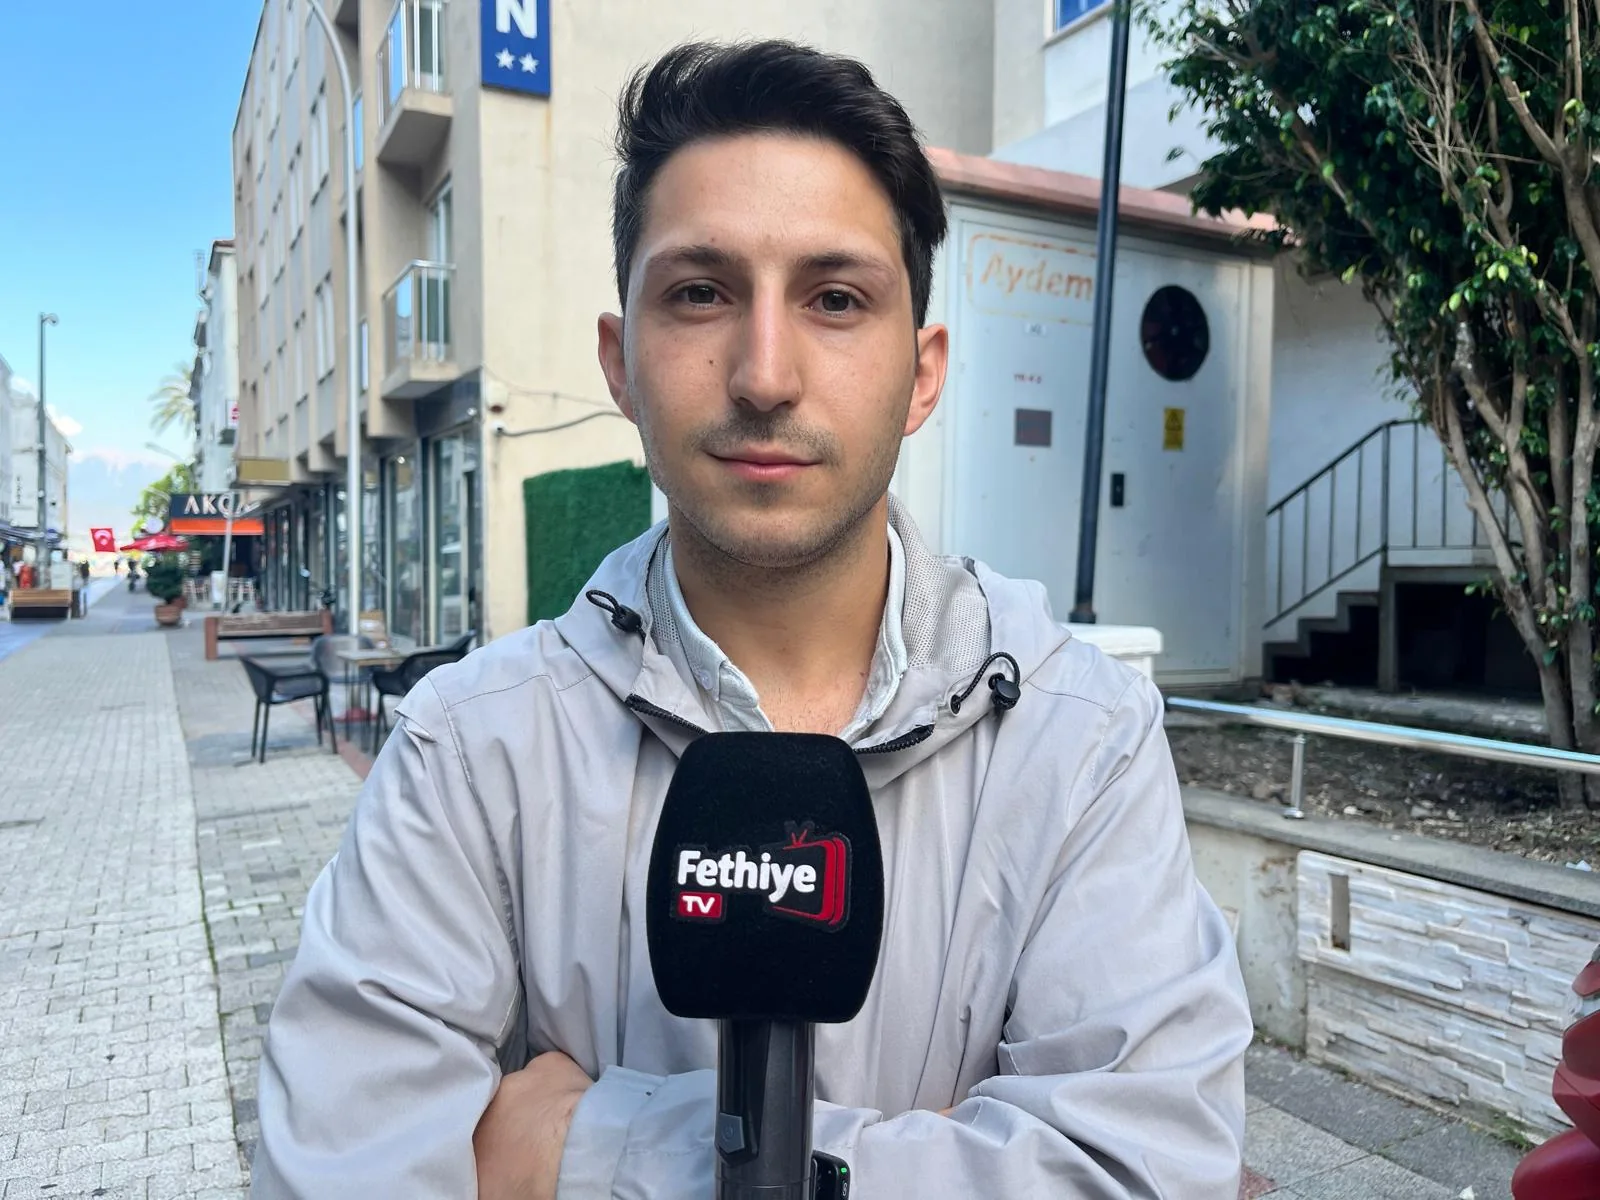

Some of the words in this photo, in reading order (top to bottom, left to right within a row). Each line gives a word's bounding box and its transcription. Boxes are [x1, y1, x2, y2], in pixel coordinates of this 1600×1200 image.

[496, 0, 538, 39] N
[981, 253, 1093, 301] Aydem
[678, 850, 816, 903] Fethiye
[682, 895, 715, 914] TV
